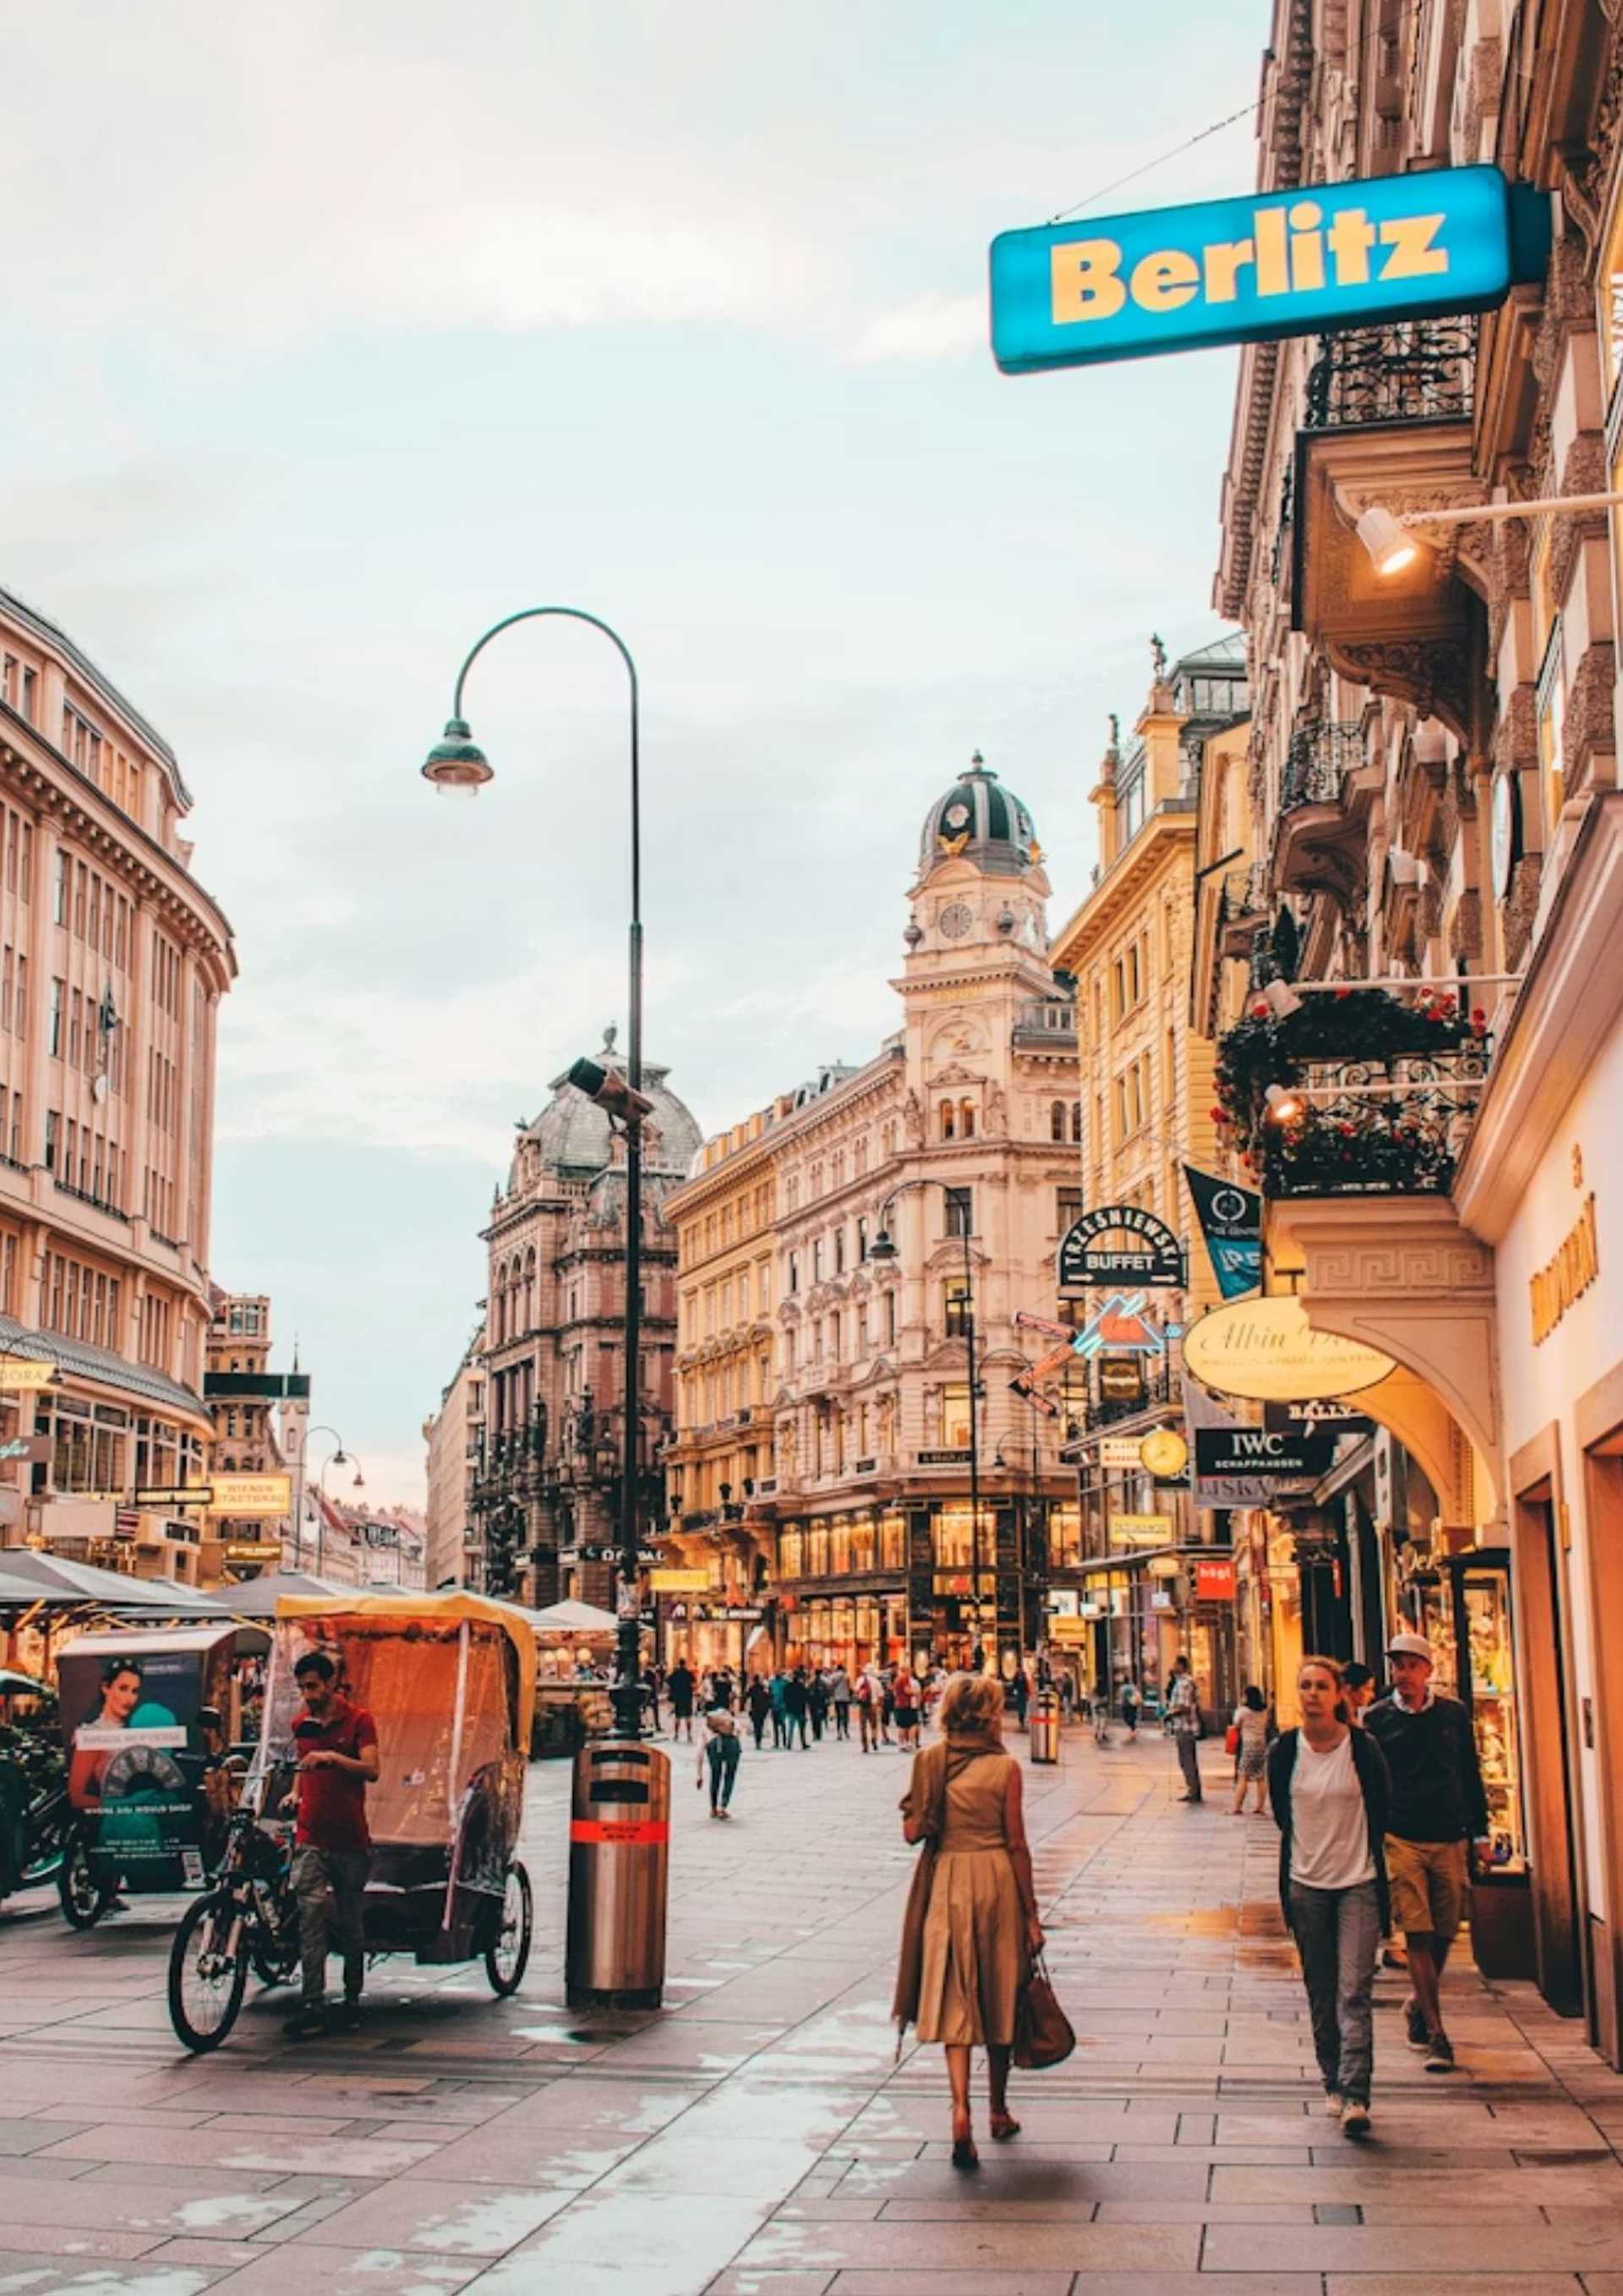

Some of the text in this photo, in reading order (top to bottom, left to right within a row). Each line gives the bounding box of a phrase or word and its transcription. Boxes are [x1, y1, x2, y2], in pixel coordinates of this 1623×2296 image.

[1051, 201, 1448, 325] Berlitz
[1086, 1254, 1155, 1270] BUFFET
[1288, 1404, 1351, 1419] BALLY
[1232, 1434, 1284, 1456] IWC
[1198, 1479, 1269, 1496] LISKA
